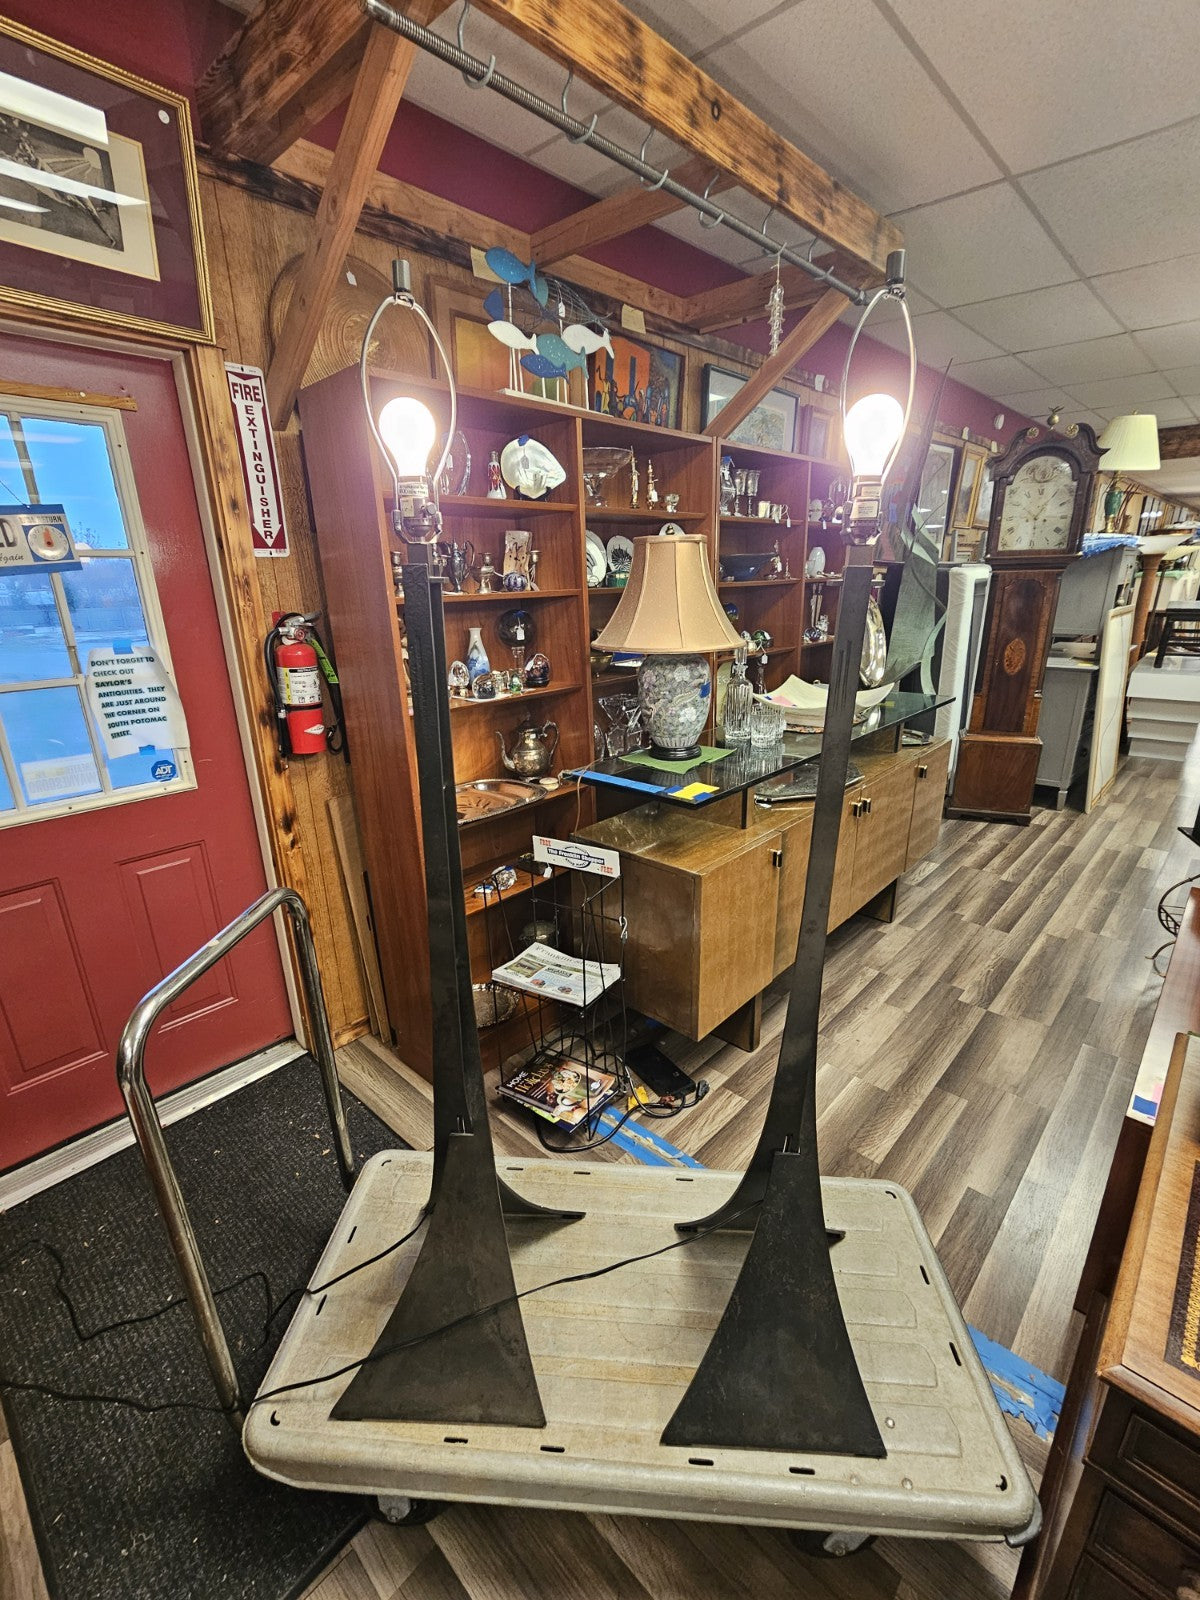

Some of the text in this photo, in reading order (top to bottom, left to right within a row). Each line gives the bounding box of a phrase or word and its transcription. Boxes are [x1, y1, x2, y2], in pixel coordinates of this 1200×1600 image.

[231, 382, 262, 403] FIRE
[244, 404, 274, 540] EXTINGUISHER
[90, 659, 115, 667] DON'T
[116, 656, 144, 665] FORGET
[92, 669, 117, 678] CHECK
[95, 679, 133, 688] SAYLOR'S
[98, 688, 145, 698] ANTIQUITIES.
[101, 701, 115, 709] ARE
[134, 696, 167, 705] AROUND
[104, 711, 116, 719] THE
[116, 708, 146, 717] CORNER
[107, 716, 168, 729] SOUTH POTOMAC
[154, 765, 173, 776] ADT
[506, 1070, 529, 1088] HOME
